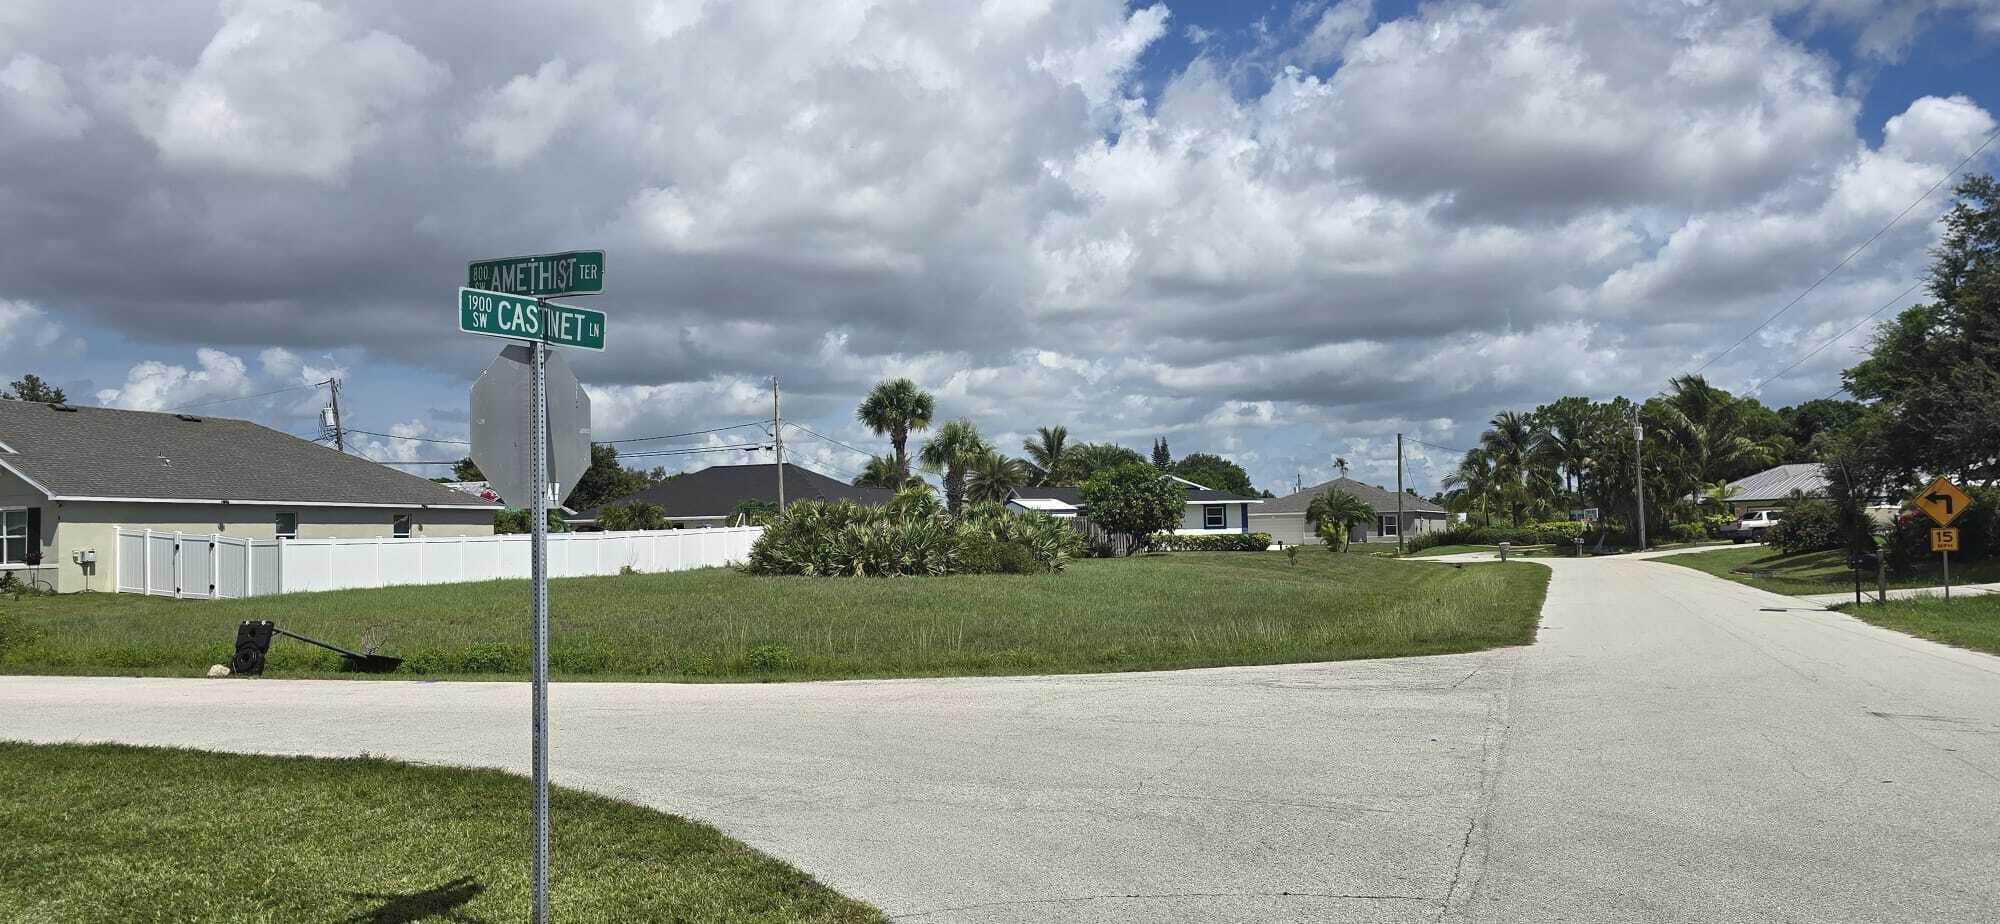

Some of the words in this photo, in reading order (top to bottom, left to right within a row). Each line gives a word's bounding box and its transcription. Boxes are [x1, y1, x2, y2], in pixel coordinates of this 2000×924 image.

[473, 265, 489, 281] 800
[490, 258, 577, 292] AMETHIST
[579, 264, 598, 279] TER
[468, 294, 492, 313] 1900
[472, 312, 488, 329] SW
[589, 322, 600, 337] LN
[1936, 531, 1953, 543] 15
